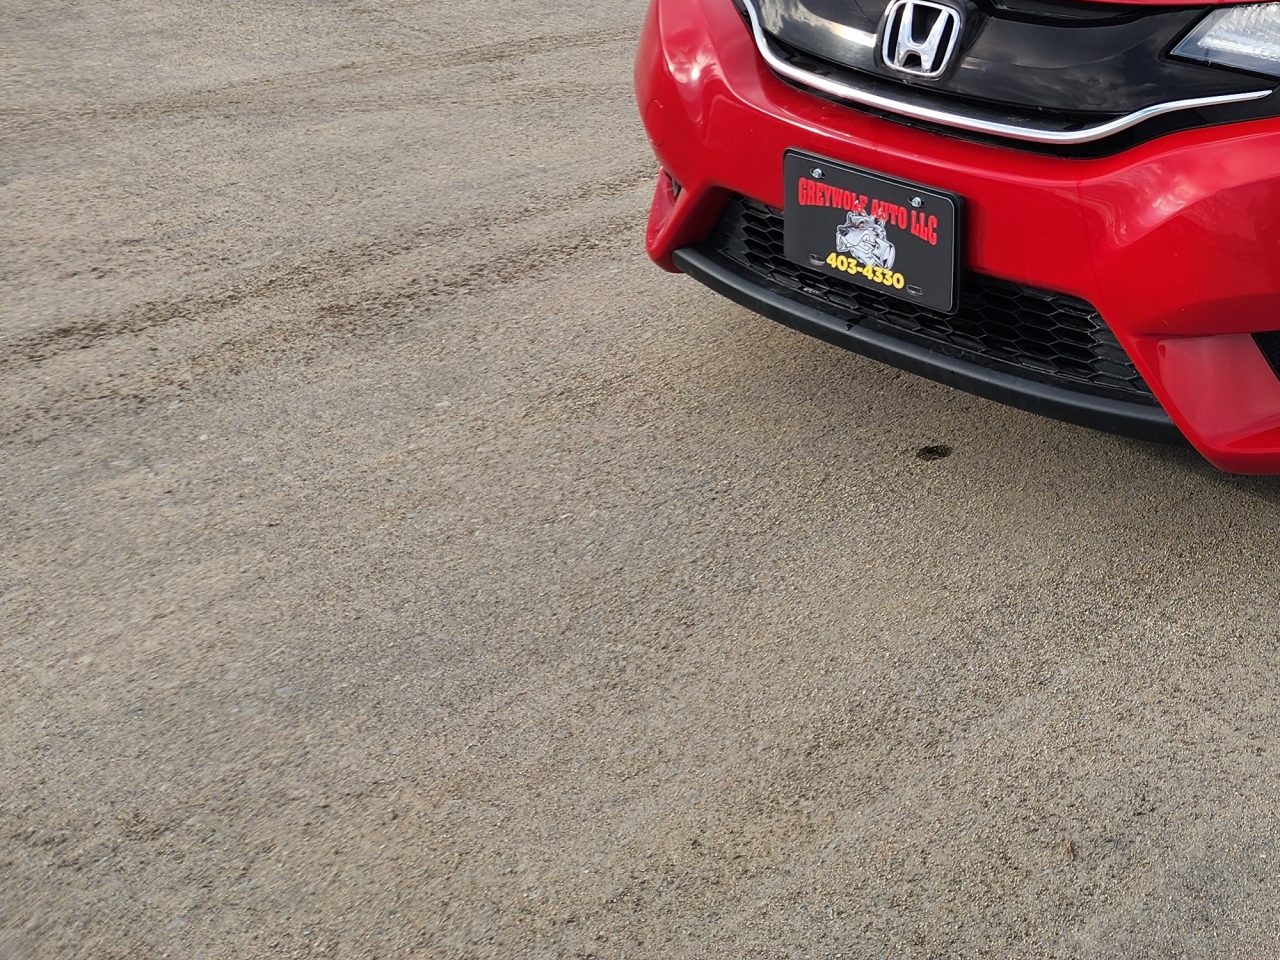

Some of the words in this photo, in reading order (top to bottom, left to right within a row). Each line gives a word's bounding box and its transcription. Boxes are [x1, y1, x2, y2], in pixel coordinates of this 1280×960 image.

[798, 177, 868, 213] GREYWOLF
[870, 198, 908, 230] AUTO
[910, 209, 938, 246] LLC
[825, 251, 906, 290] 403-4330
